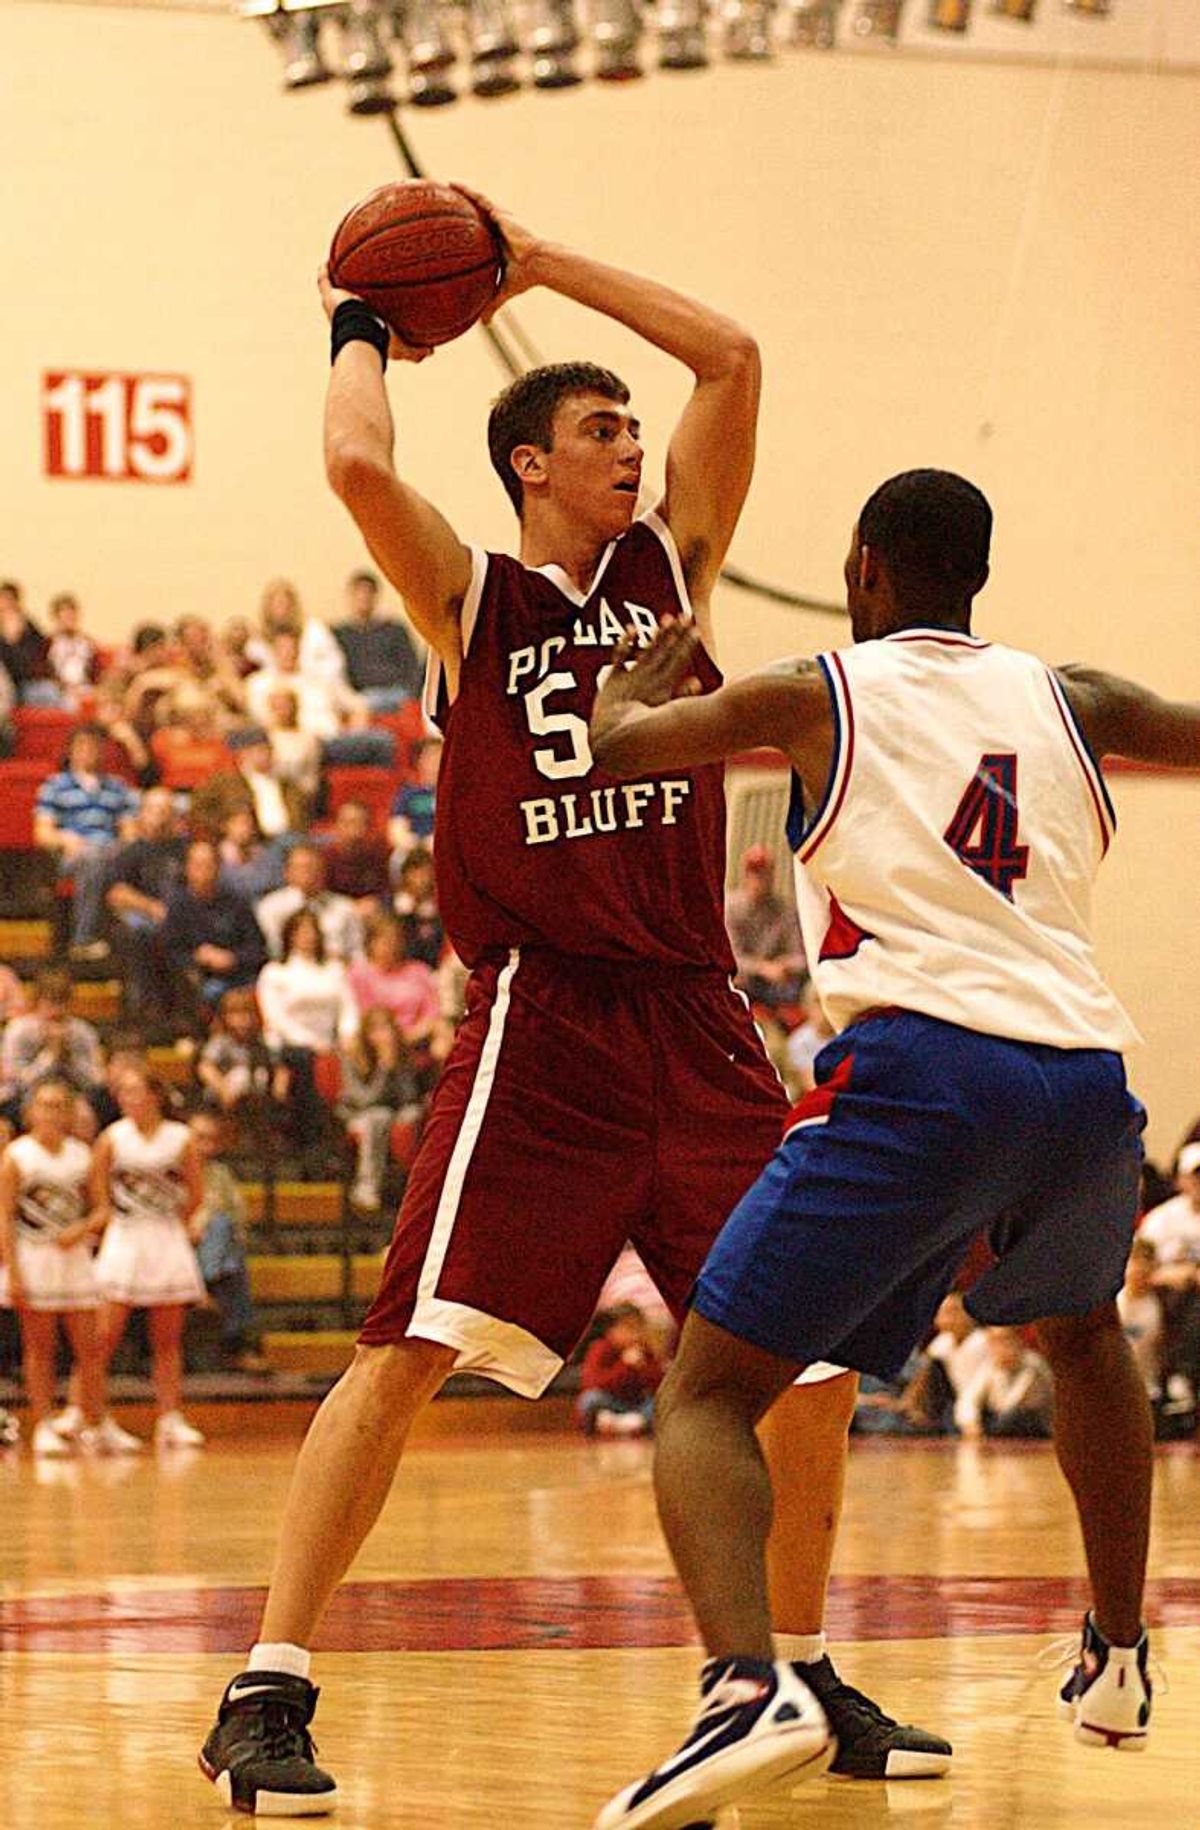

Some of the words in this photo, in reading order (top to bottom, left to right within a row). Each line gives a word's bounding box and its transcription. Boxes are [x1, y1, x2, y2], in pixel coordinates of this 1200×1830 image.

[49, 377, 186, 475] 115
[520, 780, 690, 845] BLUFF
[943, 754, 1030, 905] 4
